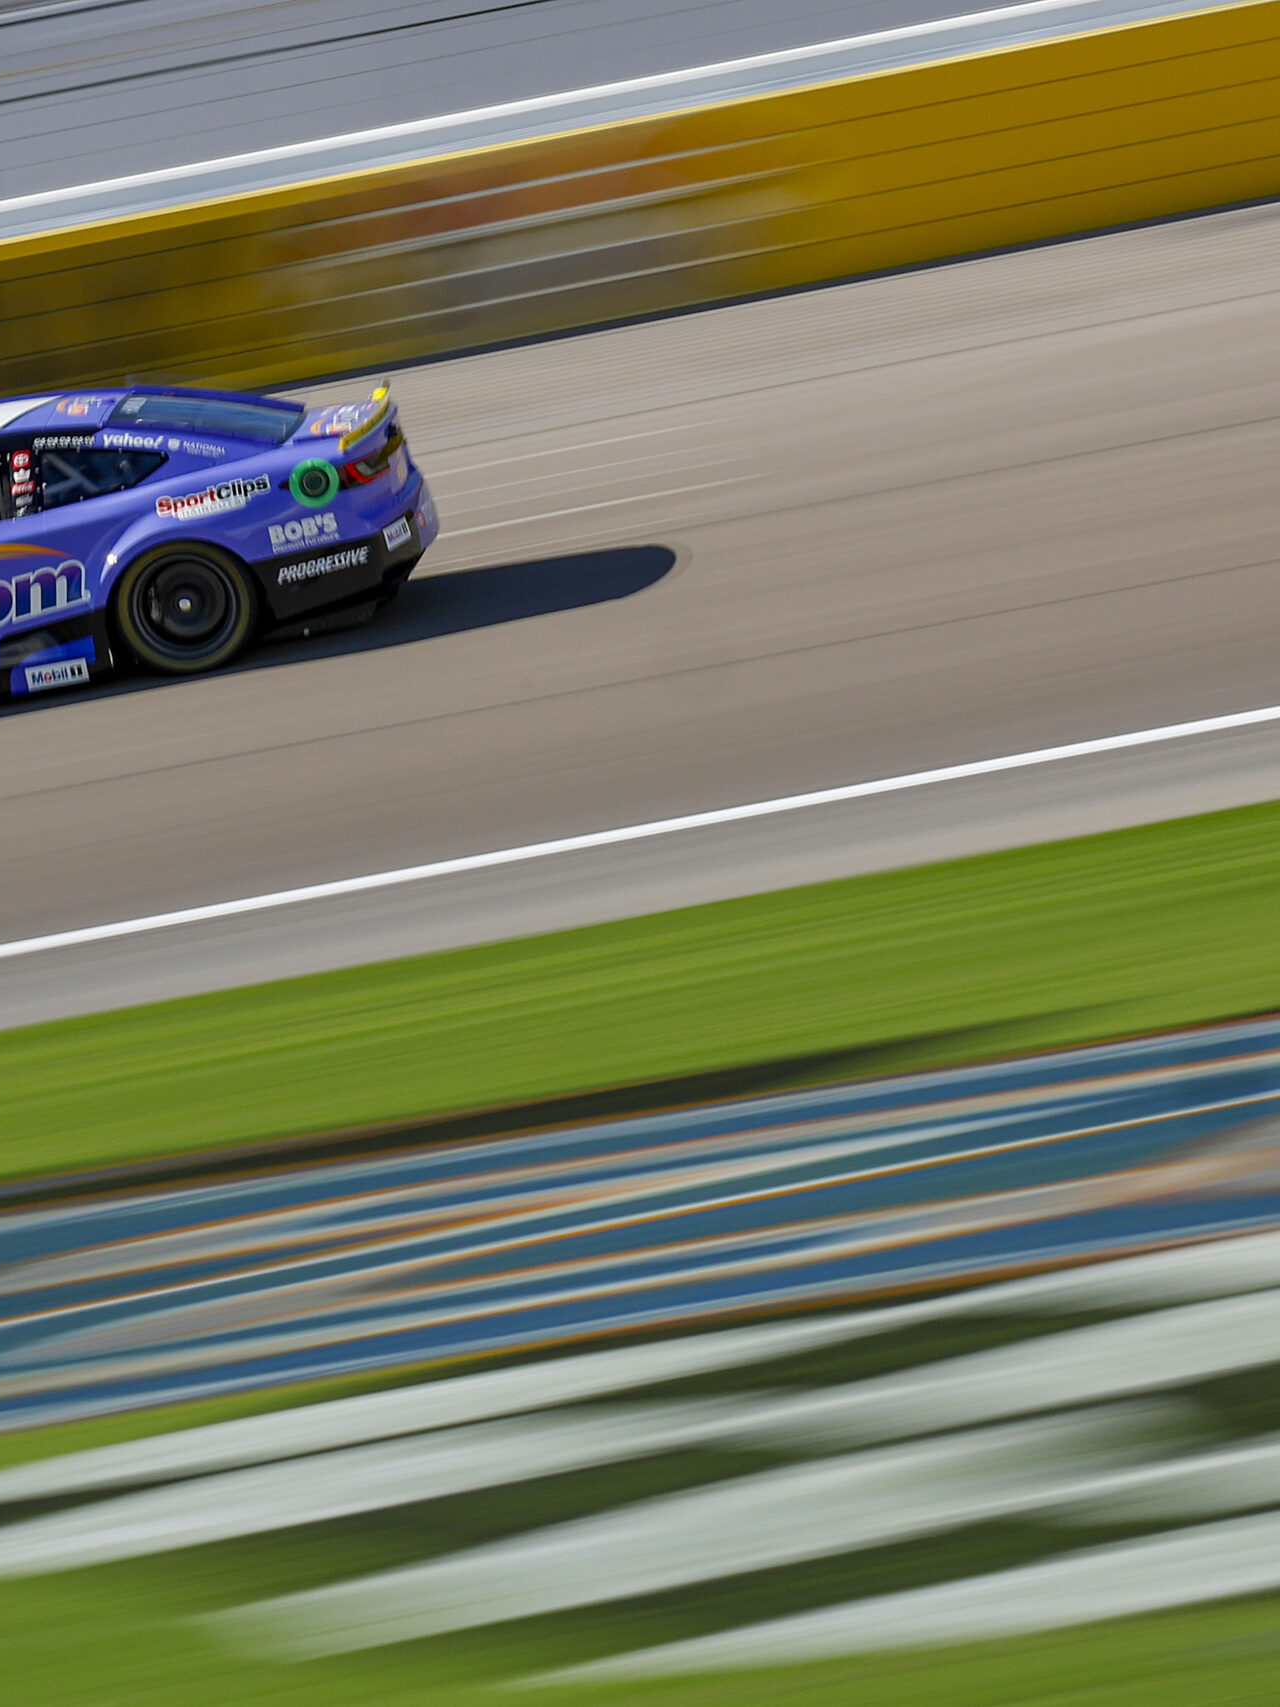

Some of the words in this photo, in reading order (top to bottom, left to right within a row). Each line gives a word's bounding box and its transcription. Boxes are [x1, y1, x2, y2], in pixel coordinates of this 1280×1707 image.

[103, 432, 164, 449] yahoo!
[155, 474, 270, 518] SportClips
[268, 512, 338, 545] BOB'S
[277, 546, 370, 586] PROGRESSIVE
[31, 667, 69, 686] Mobil
